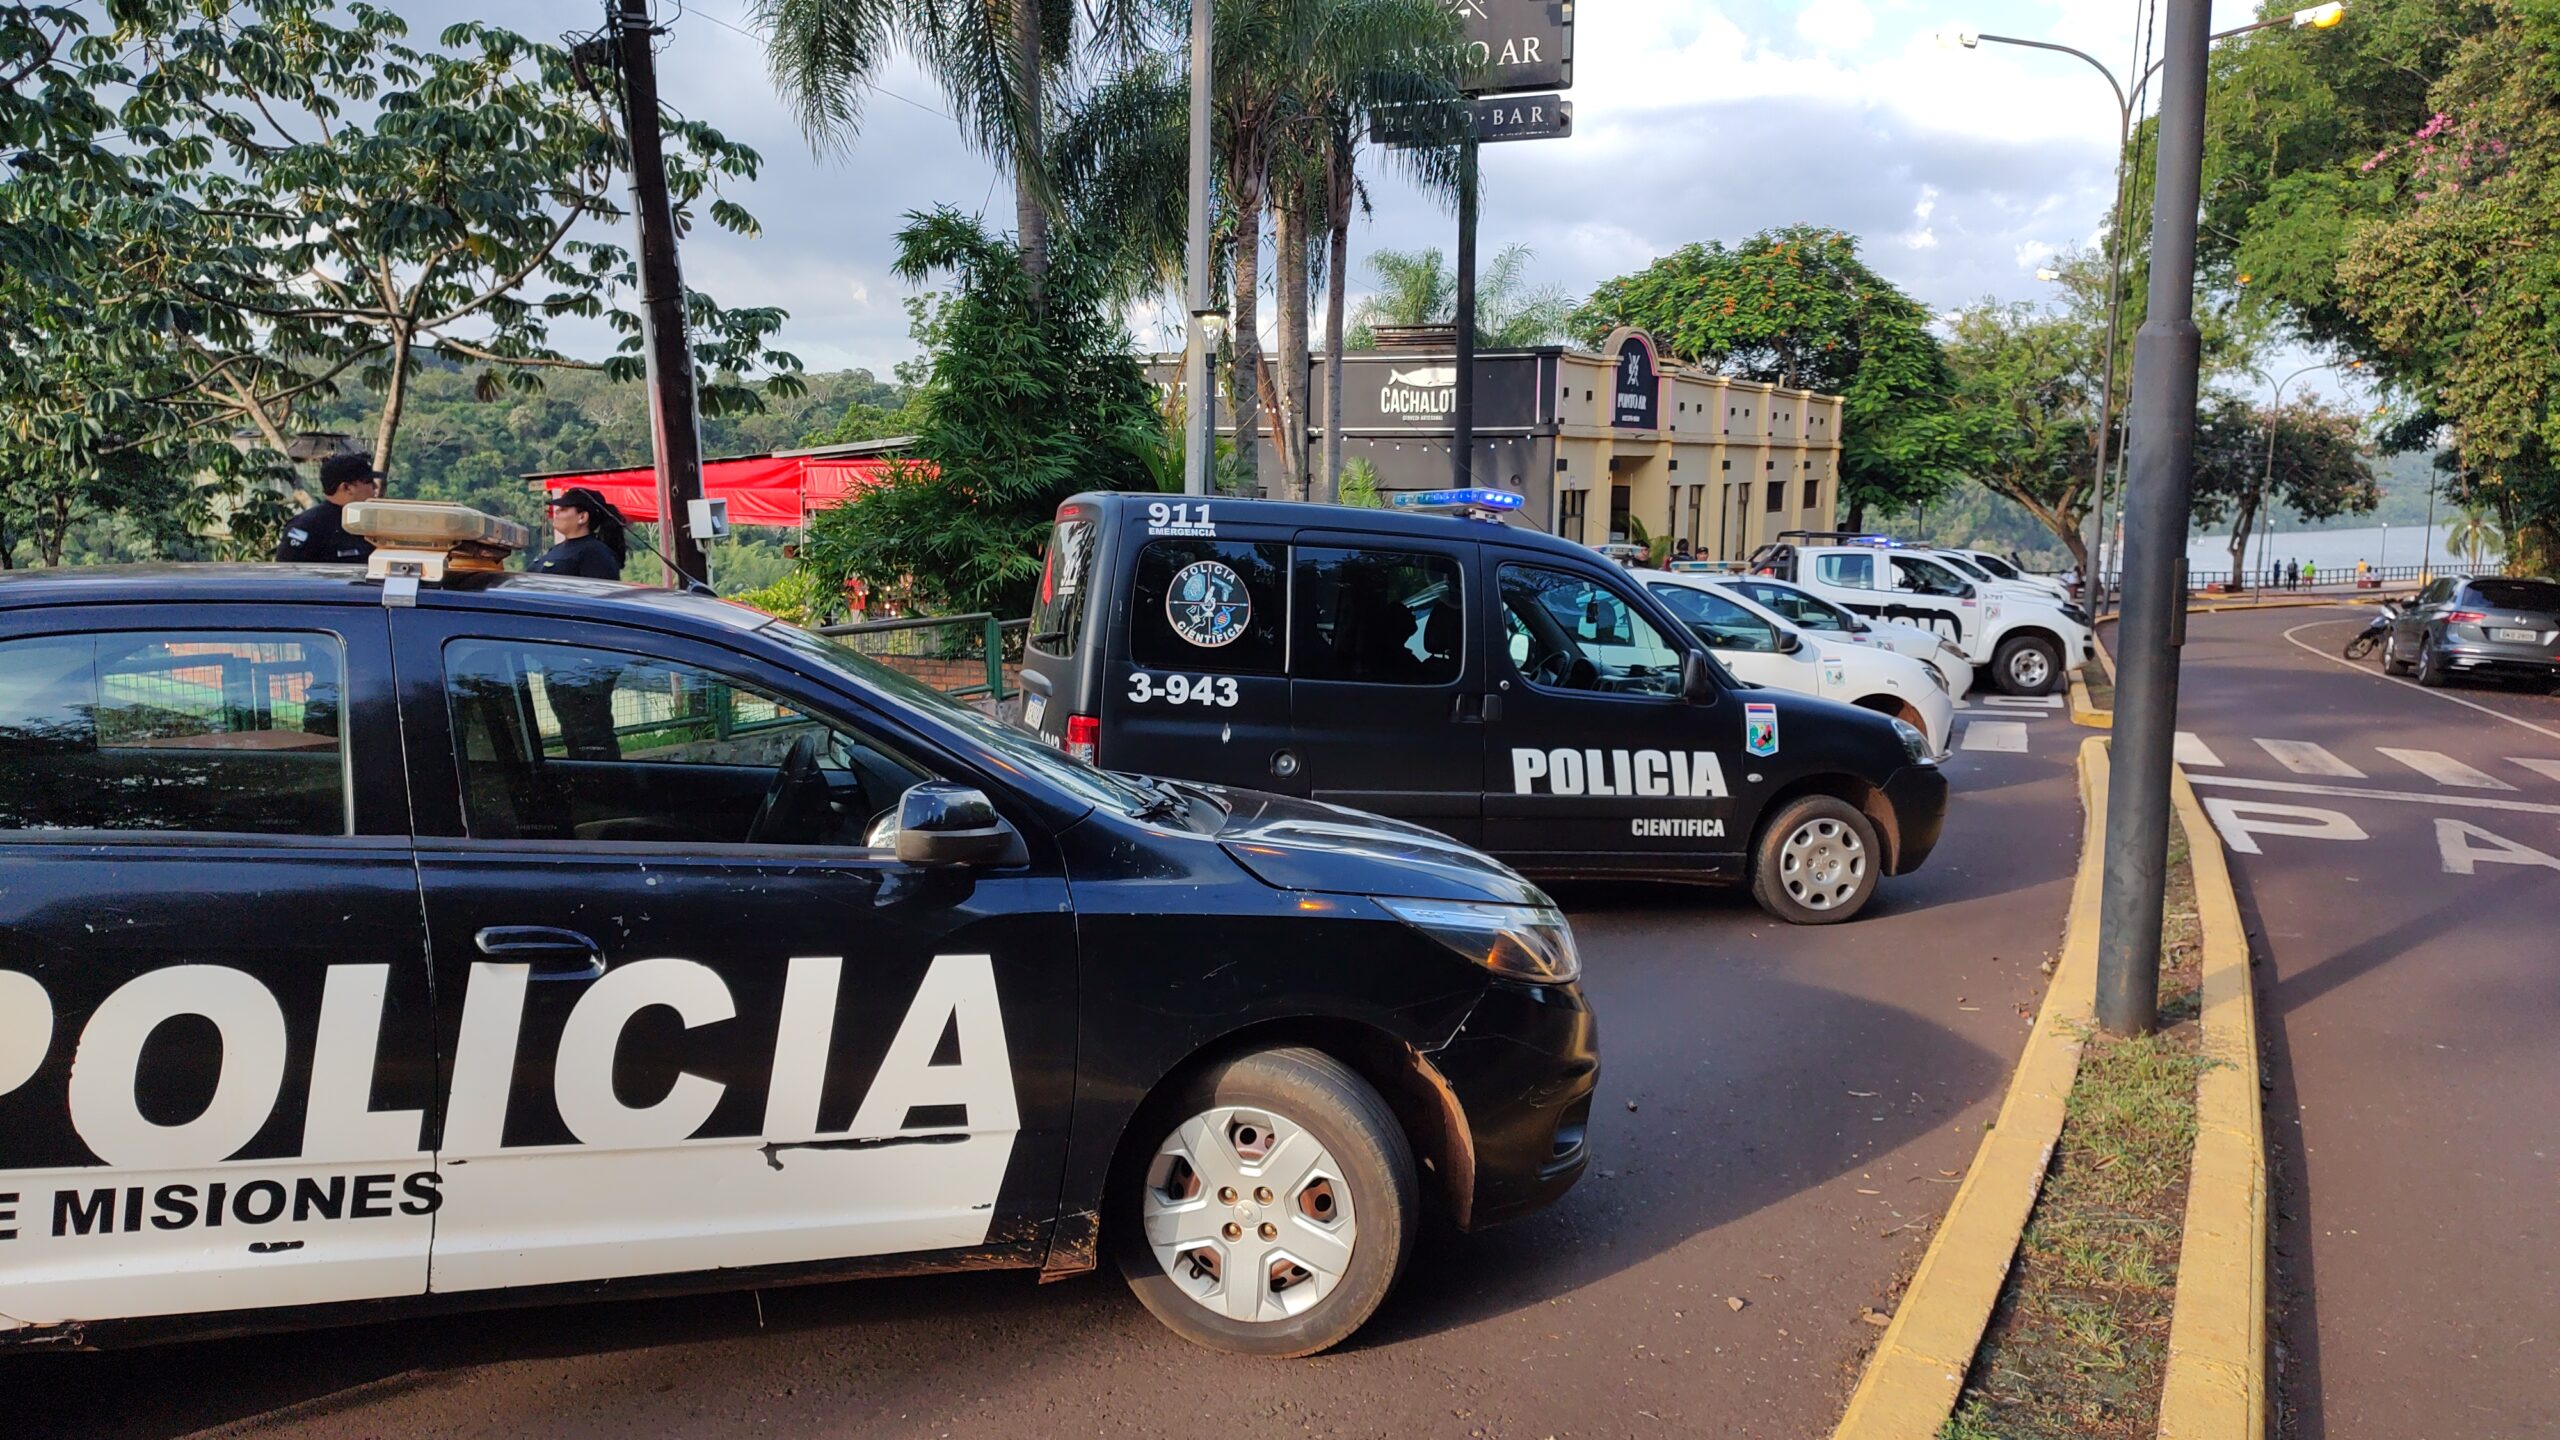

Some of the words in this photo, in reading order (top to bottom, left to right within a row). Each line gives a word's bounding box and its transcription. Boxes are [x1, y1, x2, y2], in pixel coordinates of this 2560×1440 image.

[1497, 37, 1543, 66] AR
[1148, 502, 1216, 529] 911
[1148, 527, 1217, 537] EMERGENCIA
[1181, 564, 1236, 584] POLICIA
[1177, 620, 1243, 644] CIENTIFICA
[1127, 672, 1239, 708] 3-943
[1511, 748, 1729, 797] POLICIA
[1631, 818, 1725, 837] CIENTIFICA
[51, 1170, 444, 1237] MISIONES
